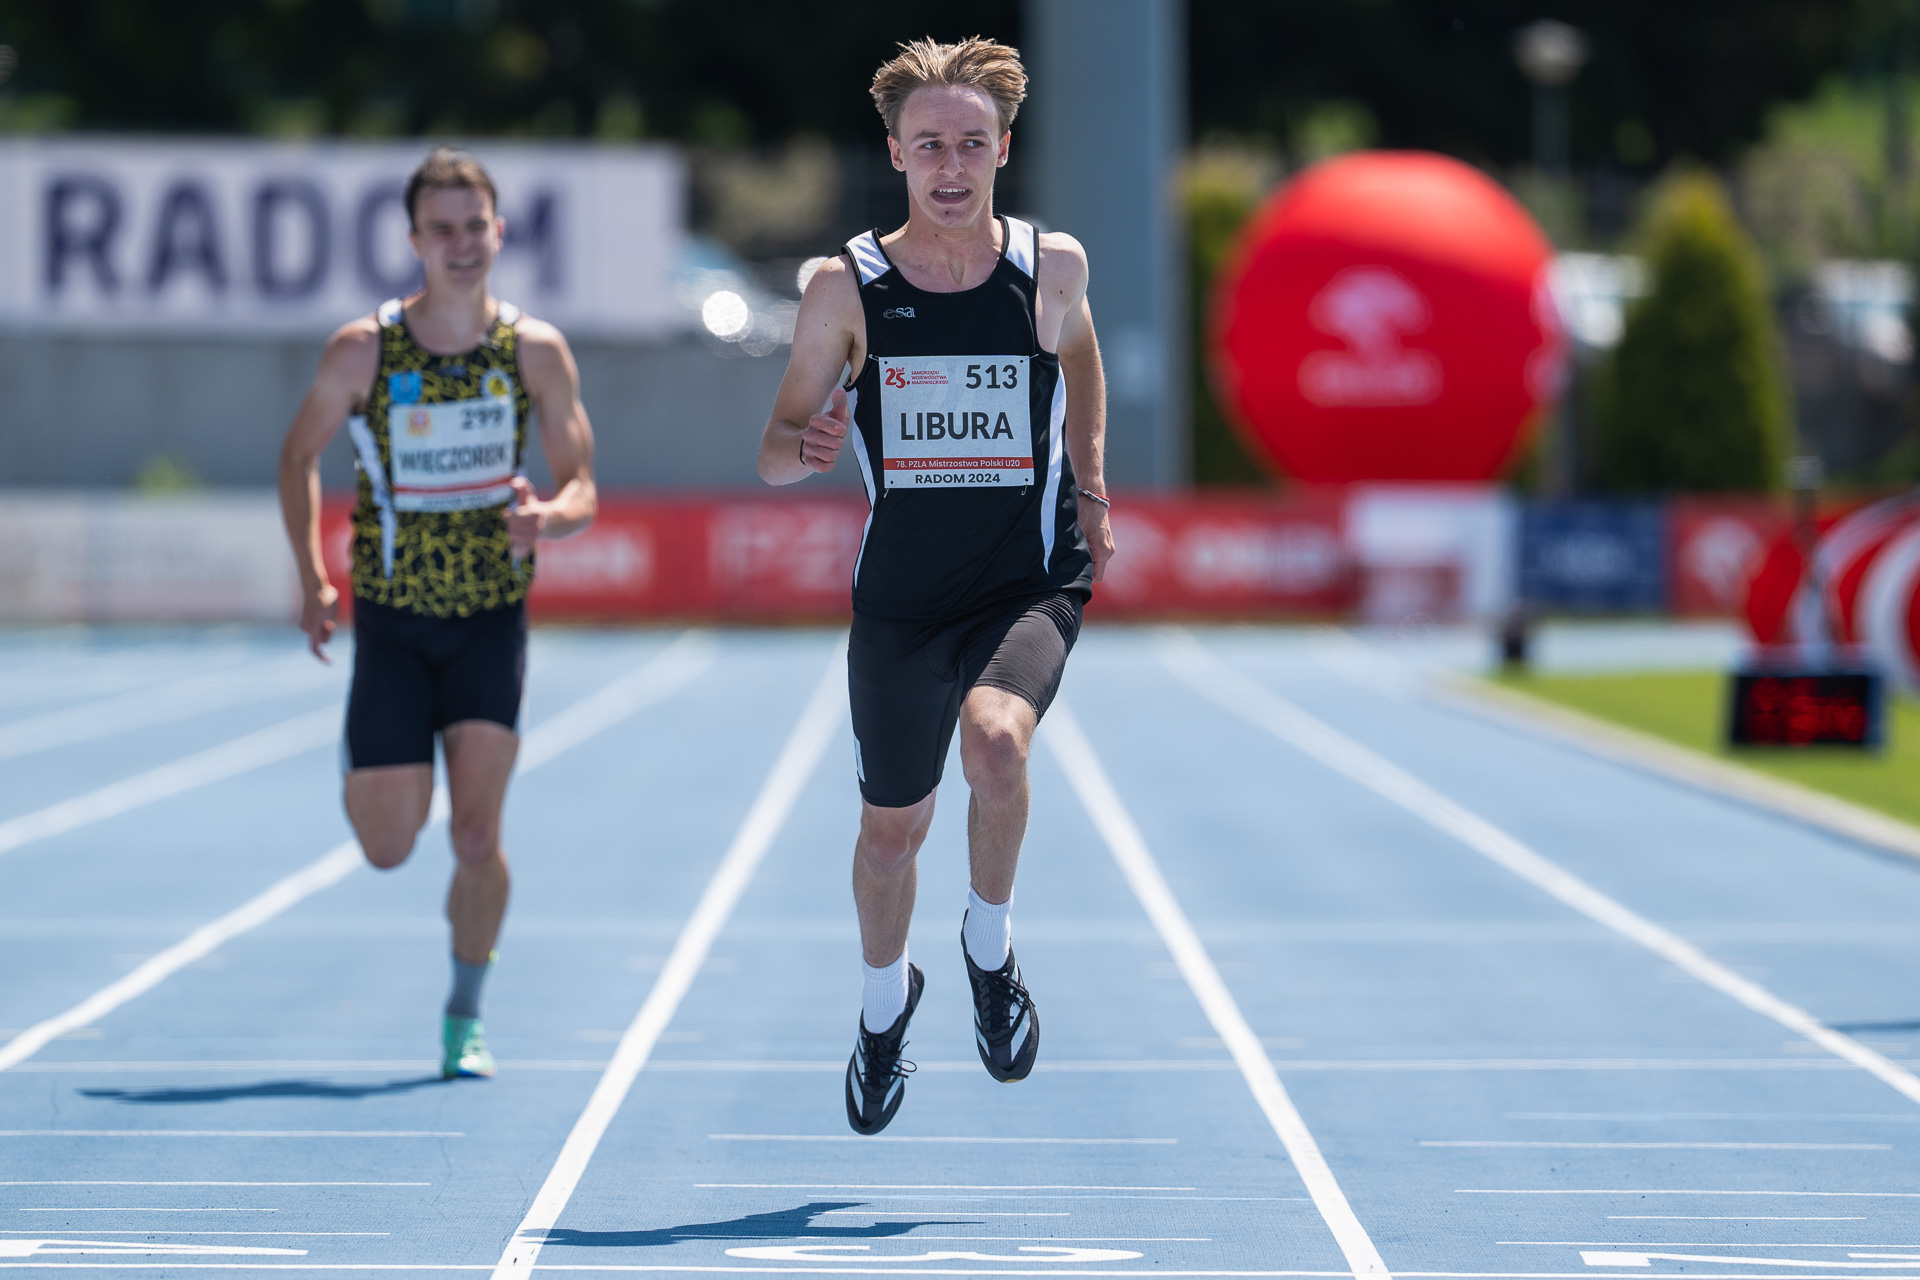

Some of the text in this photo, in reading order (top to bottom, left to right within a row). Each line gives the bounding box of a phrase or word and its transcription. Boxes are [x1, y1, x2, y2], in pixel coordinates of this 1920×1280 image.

[965, 364, 1018, 389] 513
[900, 411, 1014, 441] LIBURA
[896, 459, 1020, 468] 78. PZLA Mistrzostwa Polski U20
[915, 473, 1001, 484] RADOM 2024
